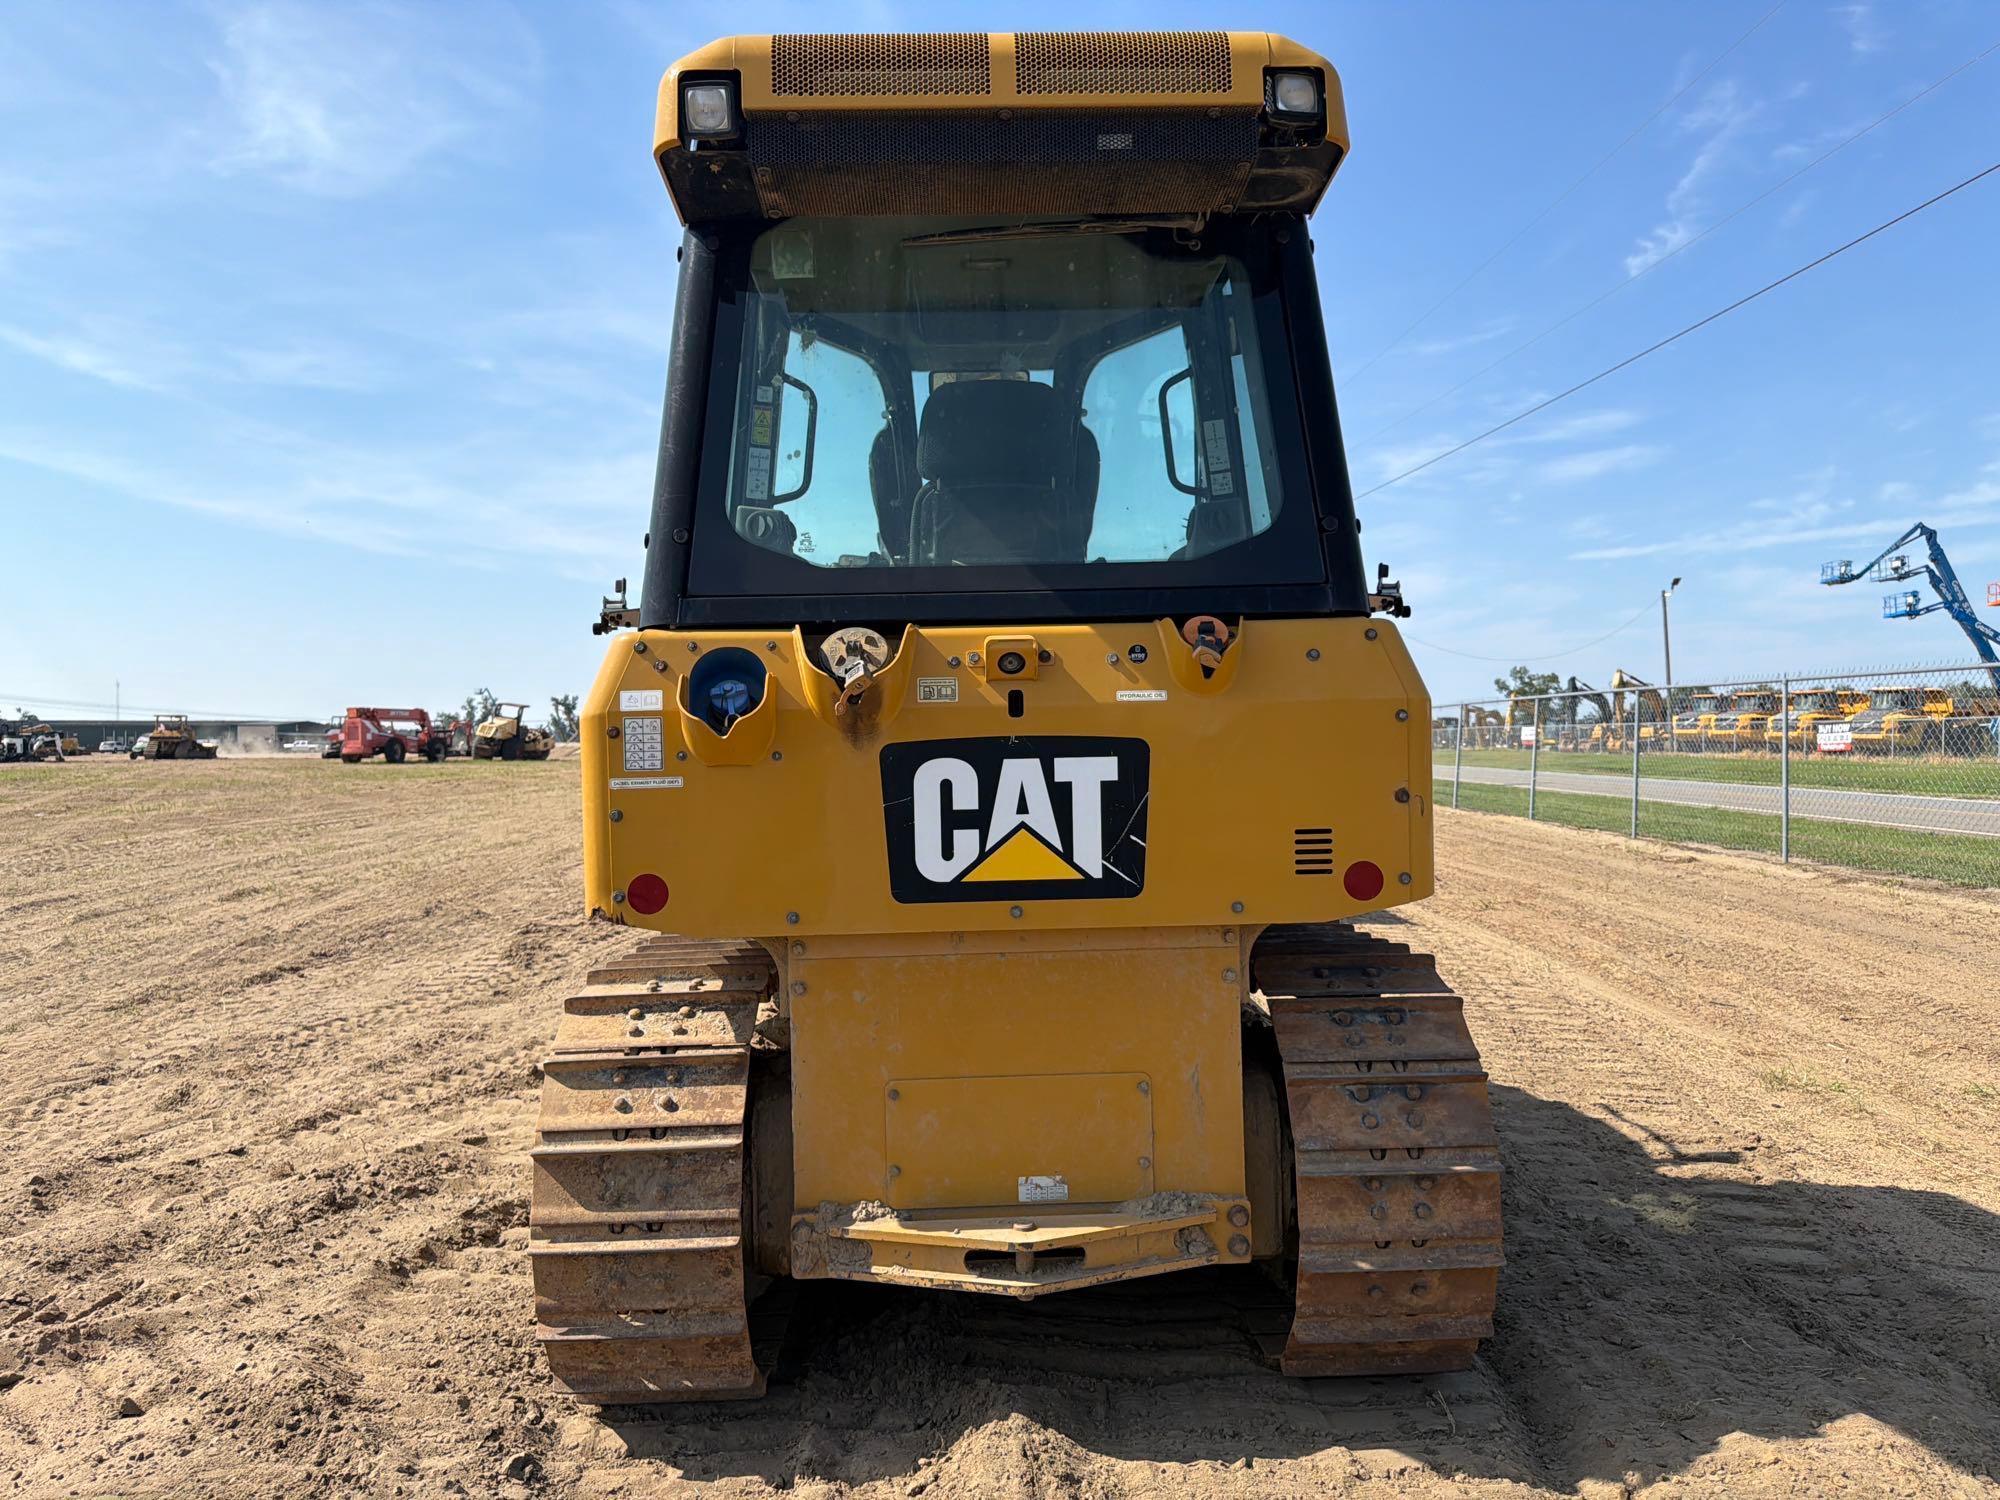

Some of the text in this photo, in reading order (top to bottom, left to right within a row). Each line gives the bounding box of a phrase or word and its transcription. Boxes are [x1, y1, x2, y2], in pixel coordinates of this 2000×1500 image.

[1974, 621, 1994, 637] Genie
[1818, 723, 1850, 734] BUY NOW
[913, 756, 1119, 883] CAT
